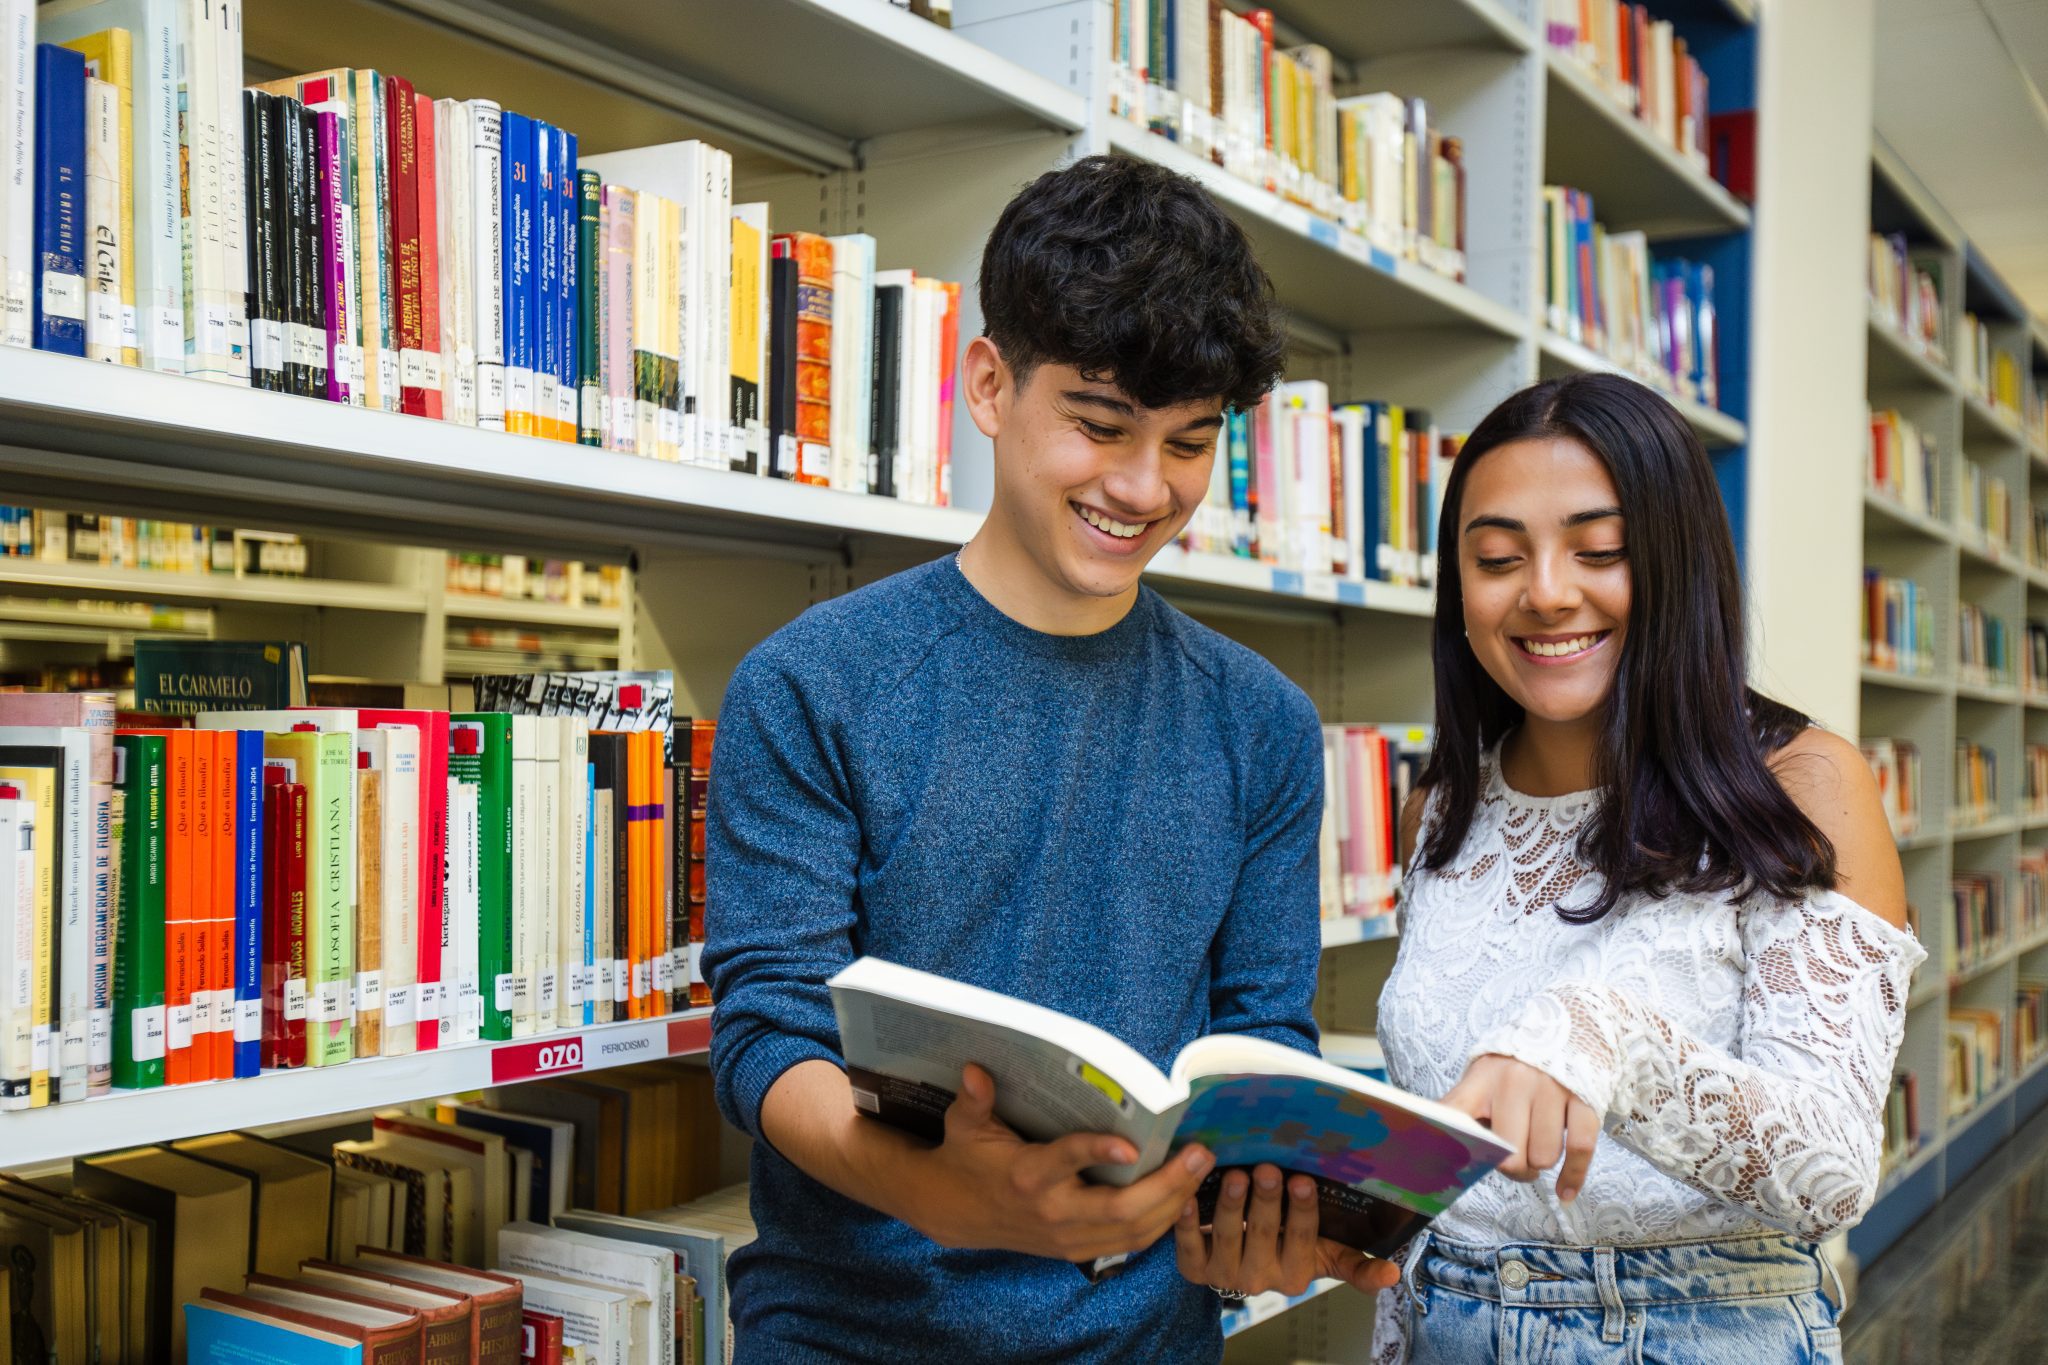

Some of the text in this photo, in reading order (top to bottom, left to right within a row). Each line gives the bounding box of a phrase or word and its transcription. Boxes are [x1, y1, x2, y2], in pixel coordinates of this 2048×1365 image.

[159, 26, 171, 80] Wittgenstein
[16, 90, 25, 108] José
[162, 94, 172, 138] Tractatus
[16, 109, 25, 137] Ramón
[60, 166, 72, 182] EL
[165, 151, 172, 162] en
[513, 161, 526, 183] 31
[15, 167, 23, 187] Vega
[163, 162, 175, 189] lógica
[352, 174, 360, 207] Escobar
[490, 156, 499, 217] FILOSOFICA
[542, 172, 553, 191] 31
[562, 178, 573, 200] 31
[706, 171, 712, 193] 2
[722, 177, 728, 199] 2
[262, 187, 271, 209] VIVIR
[292, 194, 301, 216] VIVIR
[309, 203, 317, 225] VIVIR
[332, 153, 345, 263] FALACIAS FILOSÓFICAS
[97, 224, 116, 248] El
[163, 198, 175, 239] Lenguaje
[264, 220, 272, 241] Rafael
[353, 208, 361, 251] Valenzuela
[265, 241, 273, 268] Corazón
[293, 227, 301, 248] Rafael
[491, 221, 500, 281] INICIACION
[512, 194, 523, 287] La filosofía personalista
[522, 239, 530, 274] de Karol
[310, 235, 320, 315] Rafael Corazón González
[401, 242, 413, 331] TREINTA DE
[492, 287, 500, 301] DE
[159, 673, 252, 699] EL CARMELO
[250, 766, 258, 785] 2004
[149, 763, 159, 830] LA FILOSOFÍA ACTUAL
[176, 756, 188, 838] ¿Qué es filosofía?
[198, 756, 209, 838] ¿Qué es filosofía?
[222, 756, 233, 838] ¿Qué es filosofía?
[68, 759, 81, 927] Nietzsche como pensador de dualidades
[329, 796, 341, 893] CRISTIANA
[575, 813, 583, 865] FILOSOFÍA
[95, 855, 109, 867] DE
[249, 828, 258, 908] Seminario de Profesores
[677, 804, 685, 915] COMUNICACIONES
[109, 868, 117, 918] BUENAVENTURA
[94, 873, 109, 957] IBEROAMERICANO
[291, 890, 304, 936] MORALES
[440, 886, 450, 948] Kierkegaard
[248, 918, 257, 987] Facultad de Filosofía
[93, 963, 108, 1009] MPOSIUM
[177, 955, 186, 992] Fernando
[538, 1043, 581, 1068] 070
[601, 1038, 650, 1055] PERIODISMO
